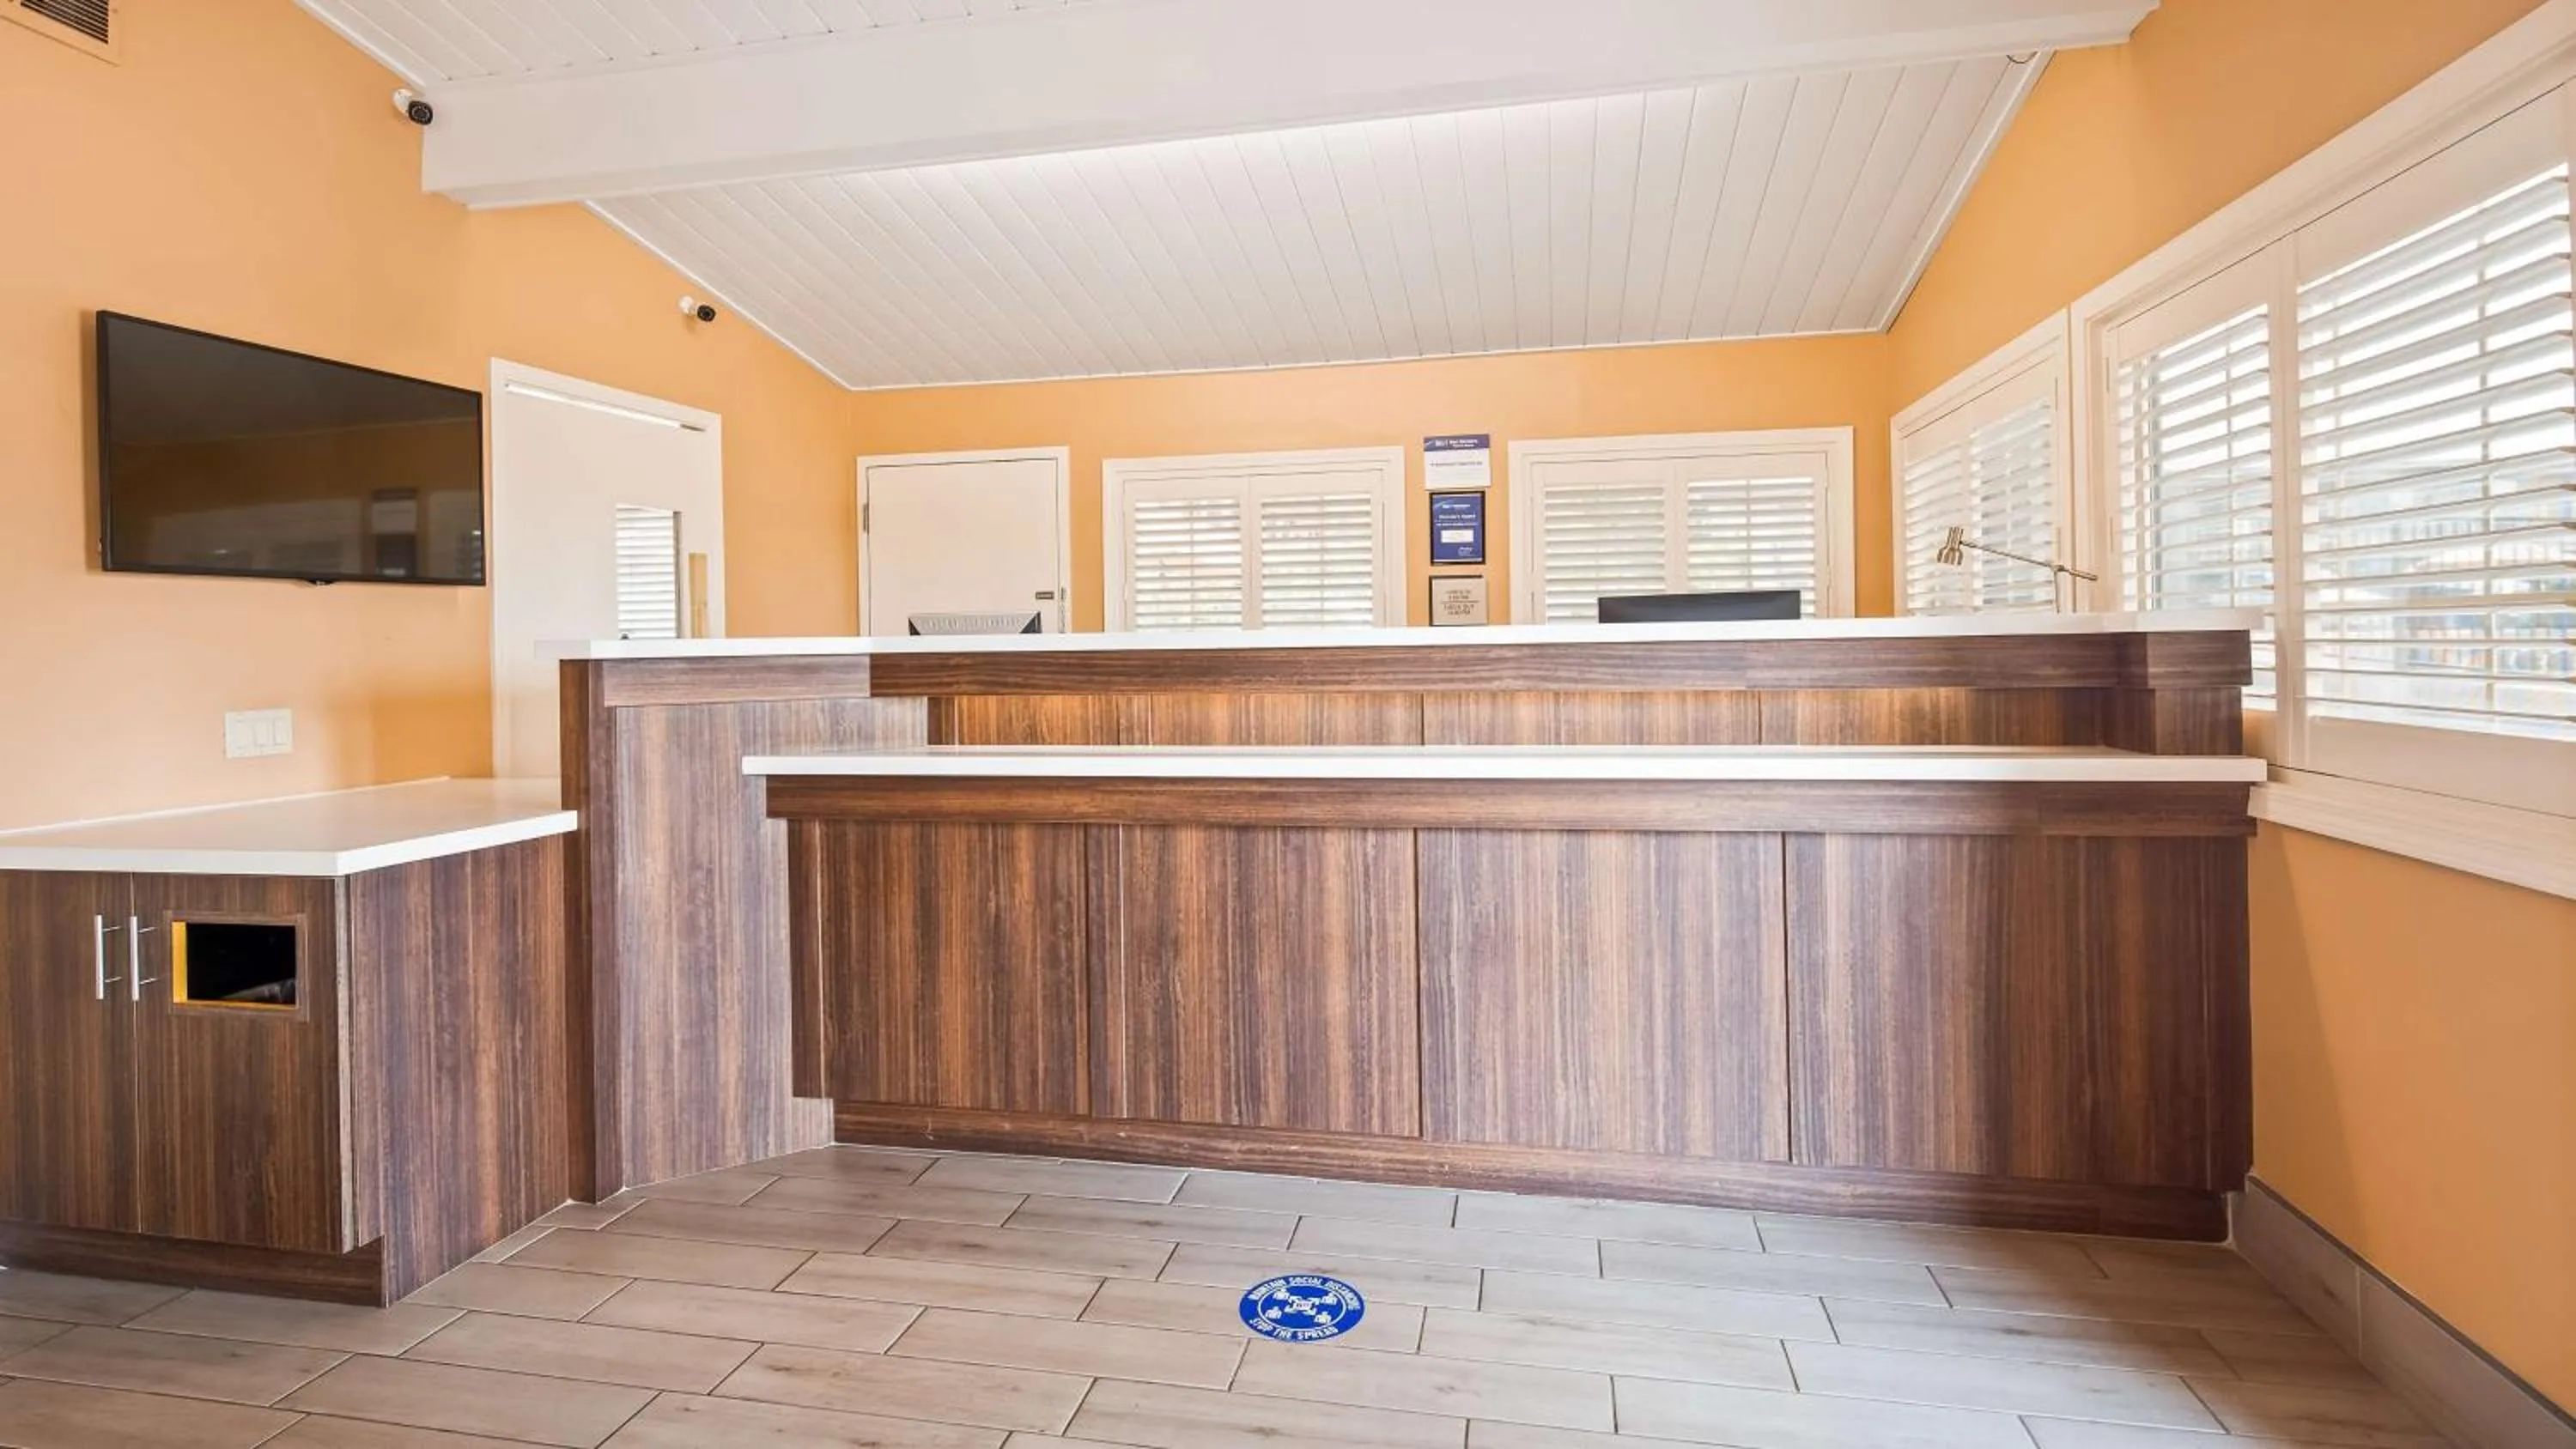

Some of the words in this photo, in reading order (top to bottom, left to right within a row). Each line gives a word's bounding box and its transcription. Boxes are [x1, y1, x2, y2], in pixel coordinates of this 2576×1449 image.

[1289, 1276, 1322, 1286] SOCIAL
[1249, 1319, 1273, 1332] STOP
[1273, 1327, 1292, 1340] THE
[1297, 1326, 1339, 1340] SPREAD
